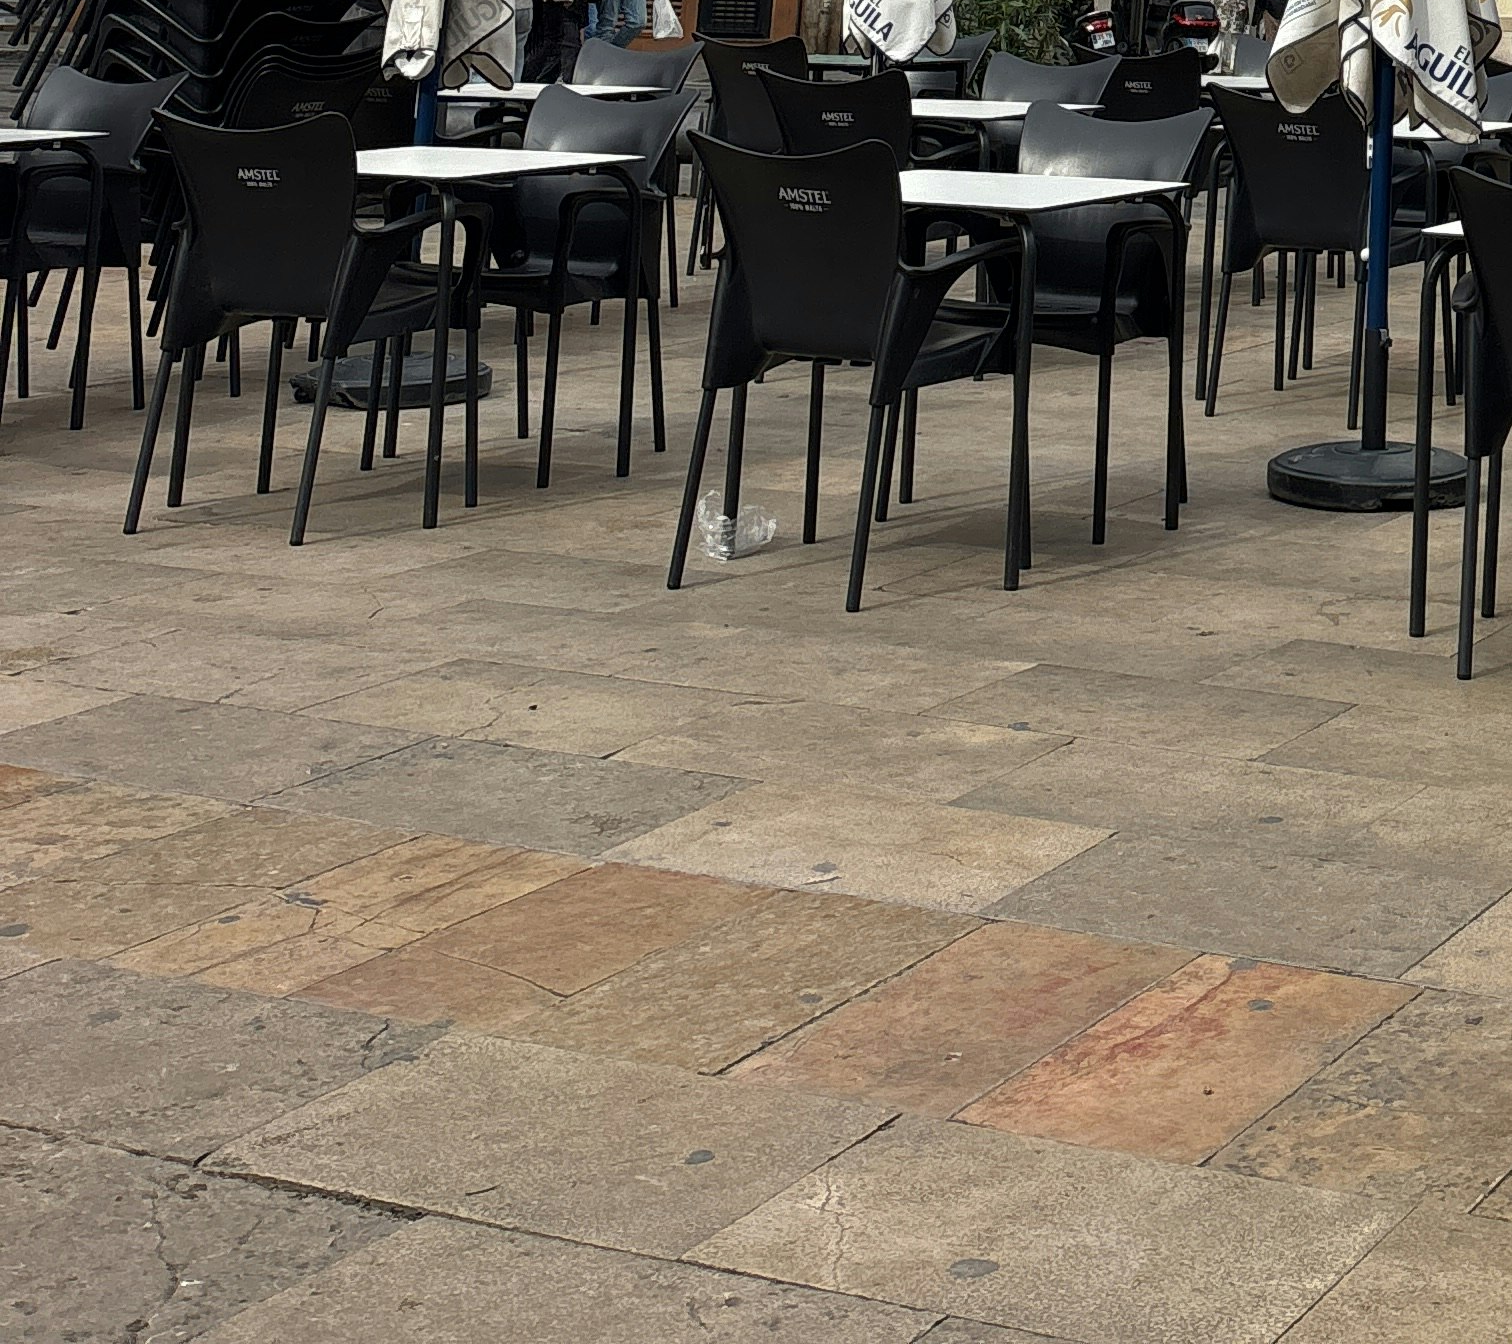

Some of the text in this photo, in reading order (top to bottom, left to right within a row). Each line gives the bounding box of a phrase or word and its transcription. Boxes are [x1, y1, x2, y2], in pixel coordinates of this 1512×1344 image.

[1454, 45, 1472, 66] EL
[291, 101, 325, 112] AMSTEL
[821, 111, 855, 122] AMSTEL
[1277, 123, 1320, 135] AMSTEL
[237, 168, 281, 181] AMSTEL
[778, 186, 832, 204] AMSTEL
